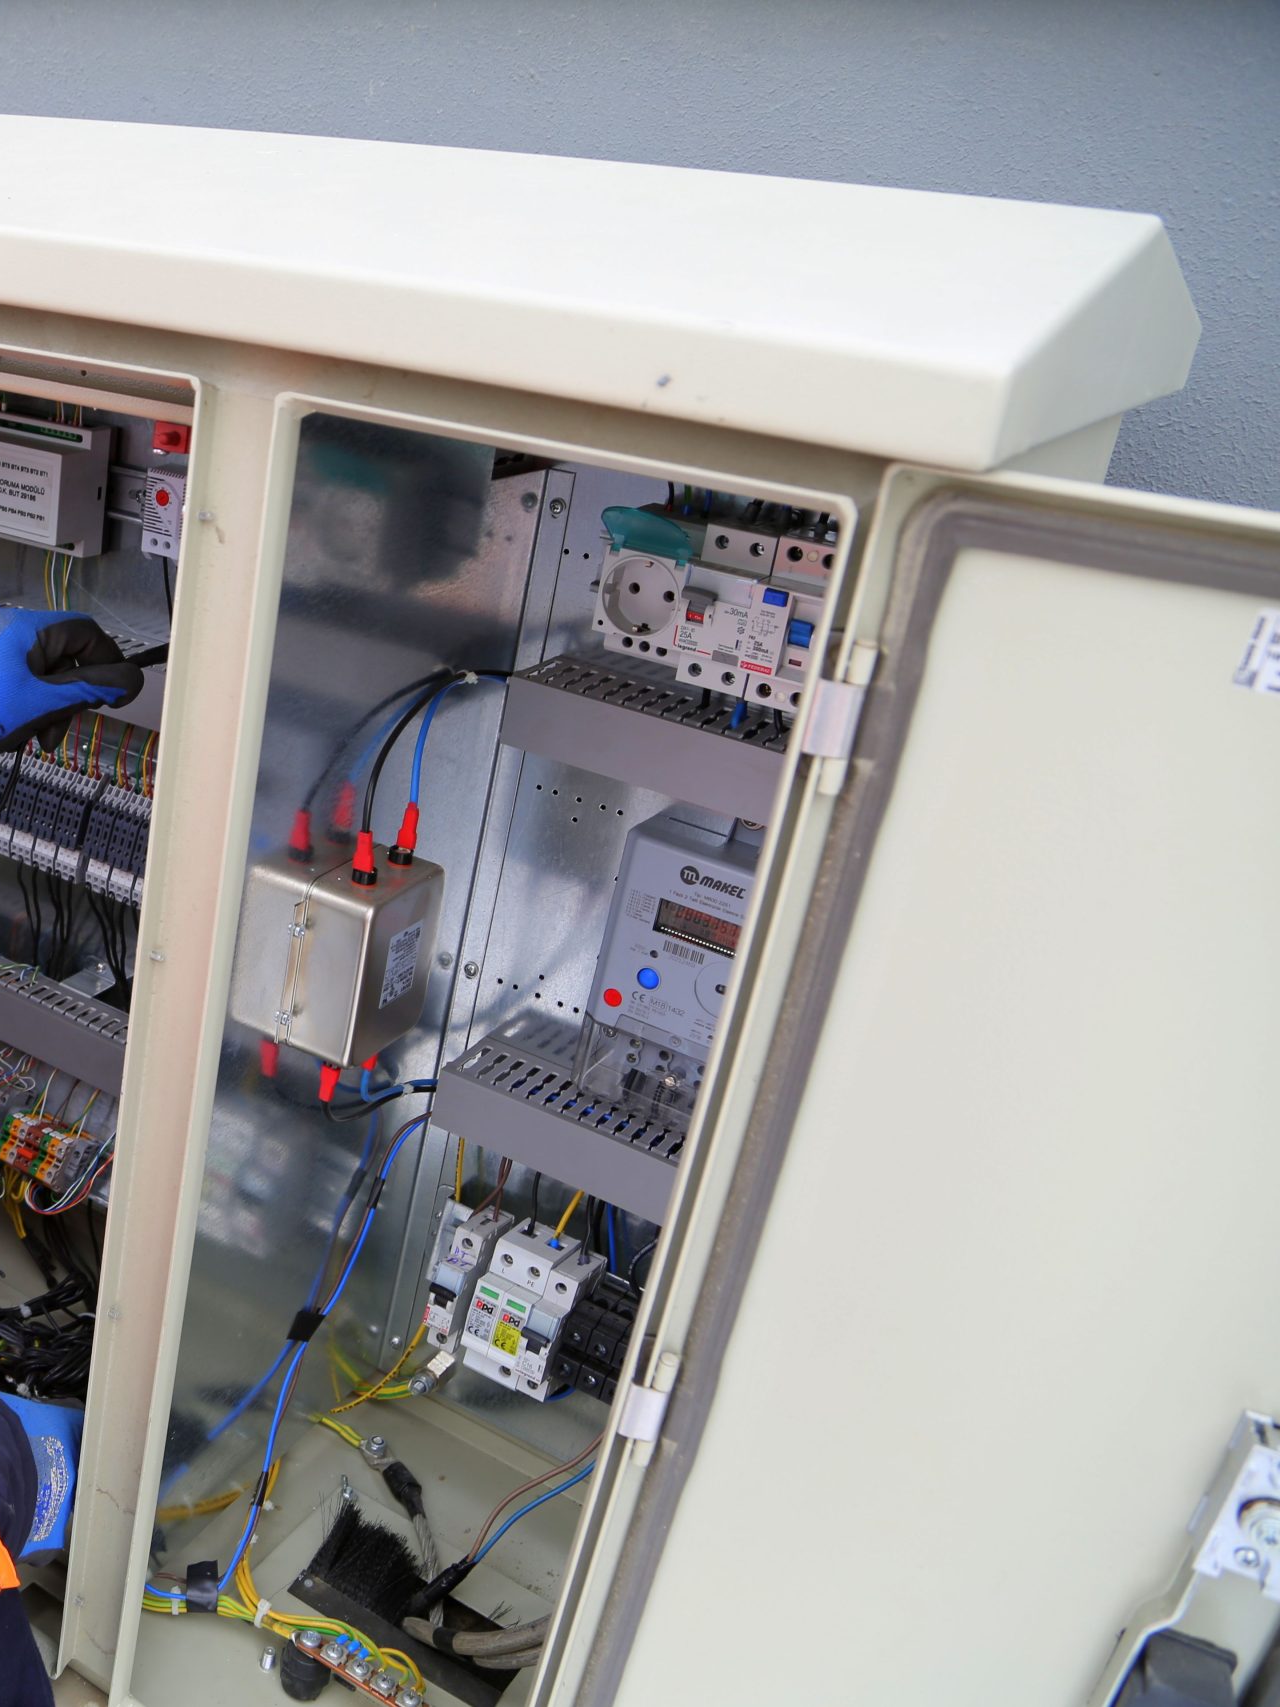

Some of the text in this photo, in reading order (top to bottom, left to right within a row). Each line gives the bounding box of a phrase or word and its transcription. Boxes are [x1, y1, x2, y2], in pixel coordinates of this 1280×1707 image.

[9, 488, 20, 497] BUT
[20, 483, 46, 495] MODÜLÜ
[679, 630, 692, 640] 25A
[677, 643, 696, 652] legrand
[700, 876, 746, 899] MAKEL
